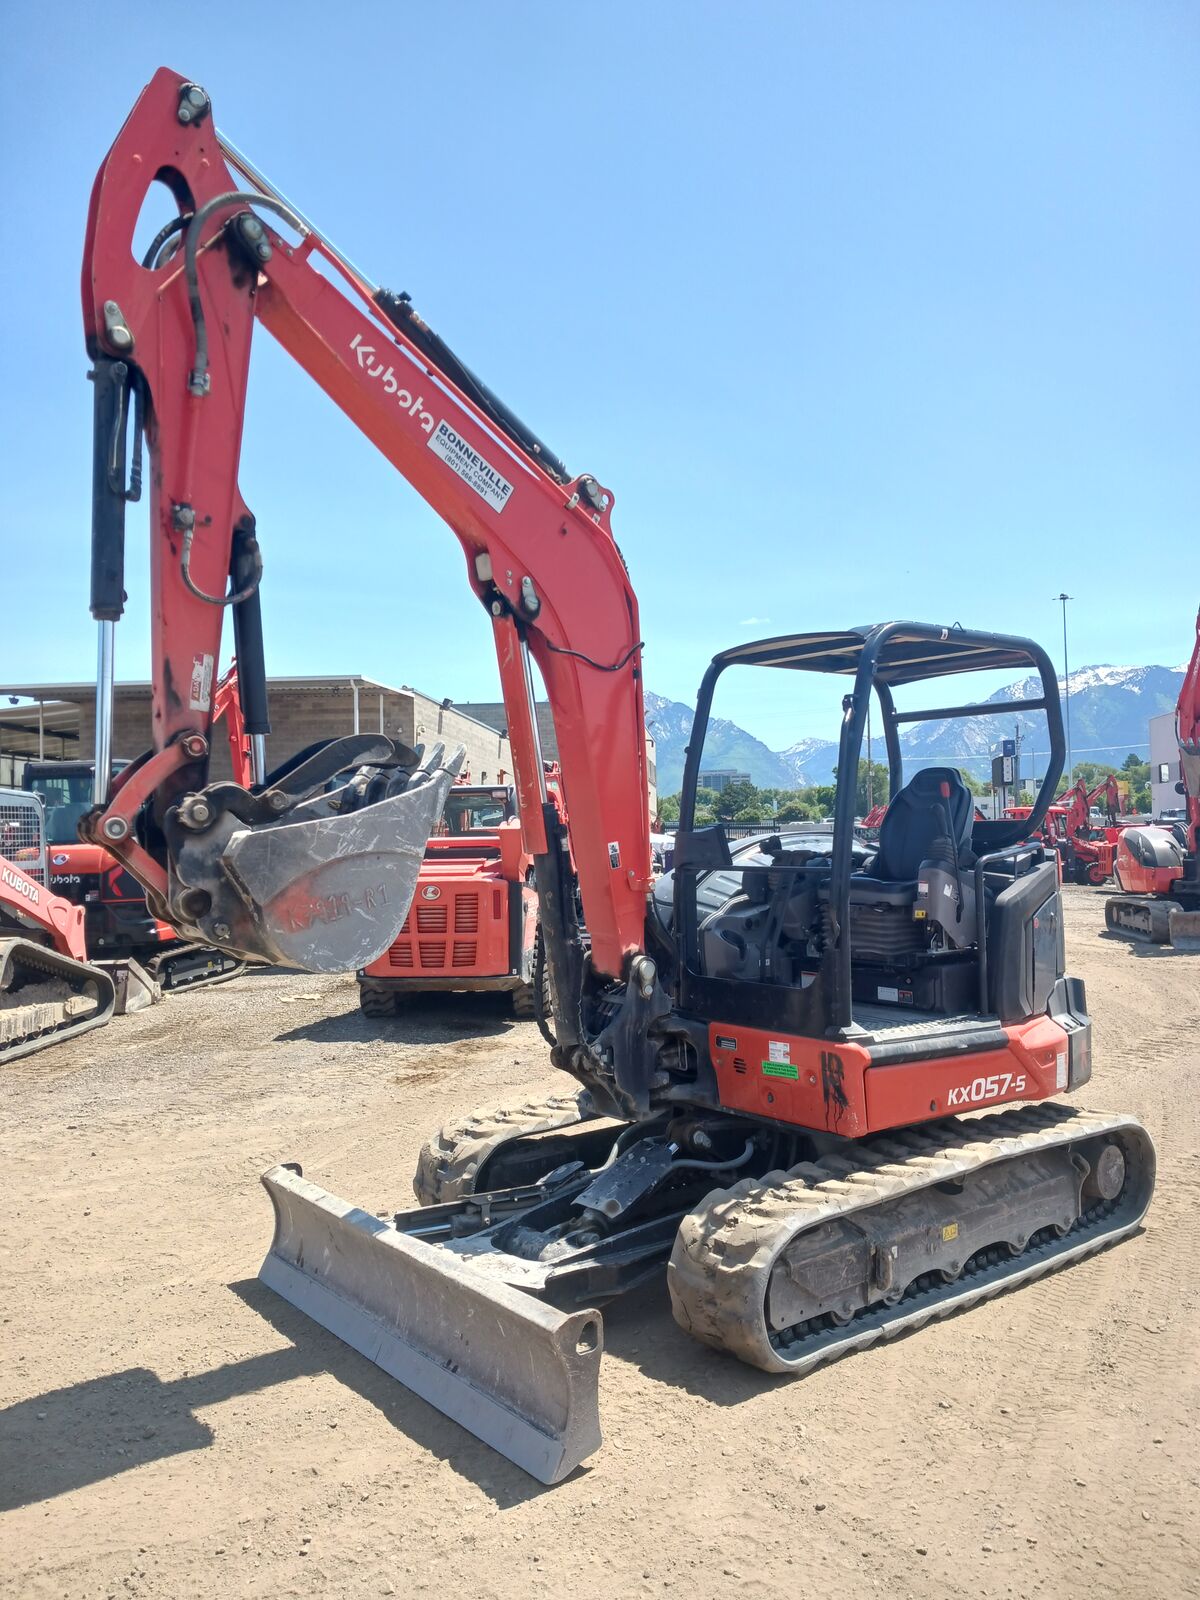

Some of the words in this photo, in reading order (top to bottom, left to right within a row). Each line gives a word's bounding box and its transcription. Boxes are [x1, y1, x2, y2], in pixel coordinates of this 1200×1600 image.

[350, 334, 434, 433] Kubota
[435, 435, 473, 471] EQUIPMENT
[473, 468, 505, 501] COMPANY
[439, 424, 511, 496] BONNEVILLE
[444, 454, 461, 471] (801)
[2, 868, 39, 904] KUBOTA
[50, 874, 81, 884] ubota
[947, 1073, 1026, 1106] KX057-5
